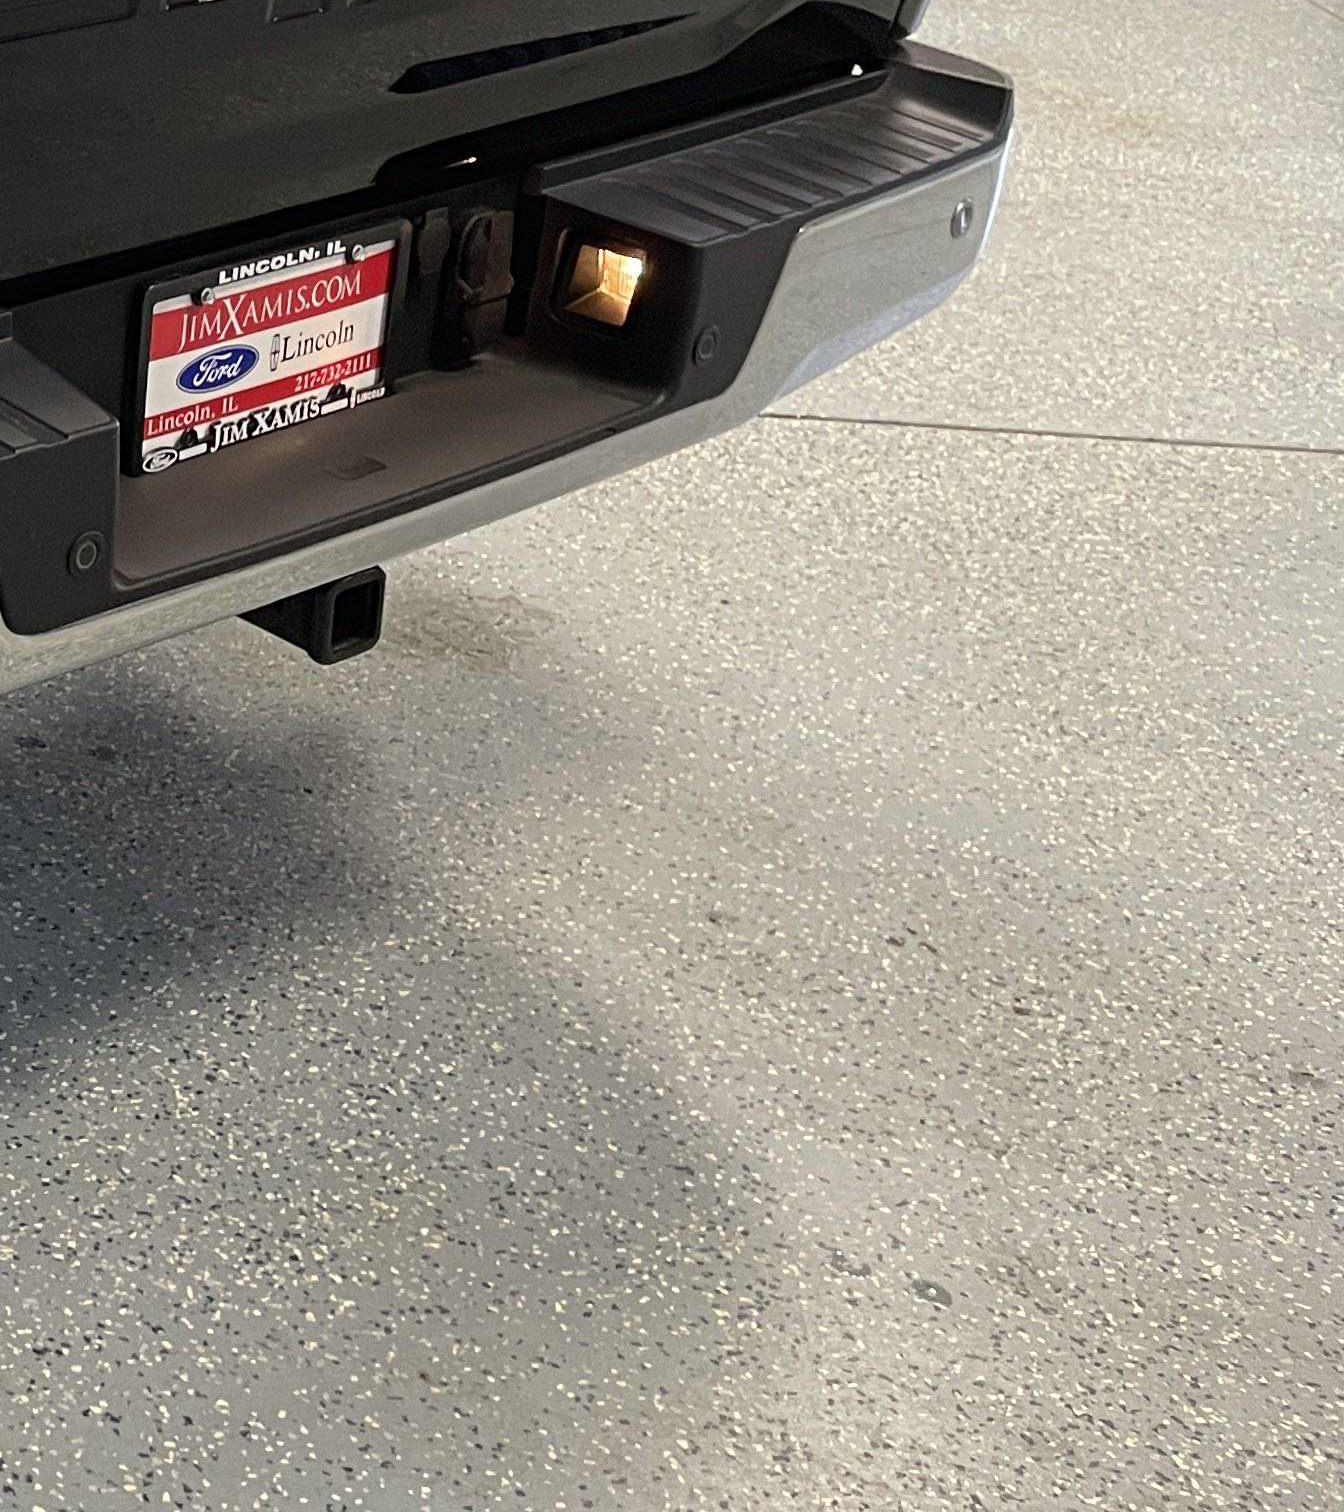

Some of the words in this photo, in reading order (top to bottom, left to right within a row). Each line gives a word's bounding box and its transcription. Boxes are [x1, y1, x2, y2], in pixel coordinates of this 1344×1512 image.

[218, 246, 320, 285] LINCOLN,
[326, 240, 347, 259] IL
[177, 270, 362, 353] JIMXAMIS.COM
[280, 319, 355, 363] Lincoln
[193, 352, 244, 387] Ford
[294, 352, 371, 393] 217-732-2111
[210, 419, 250, 453] JIM
[251, 397, 320, 437] XAMIS
[222, 396, 239, 414] IL
